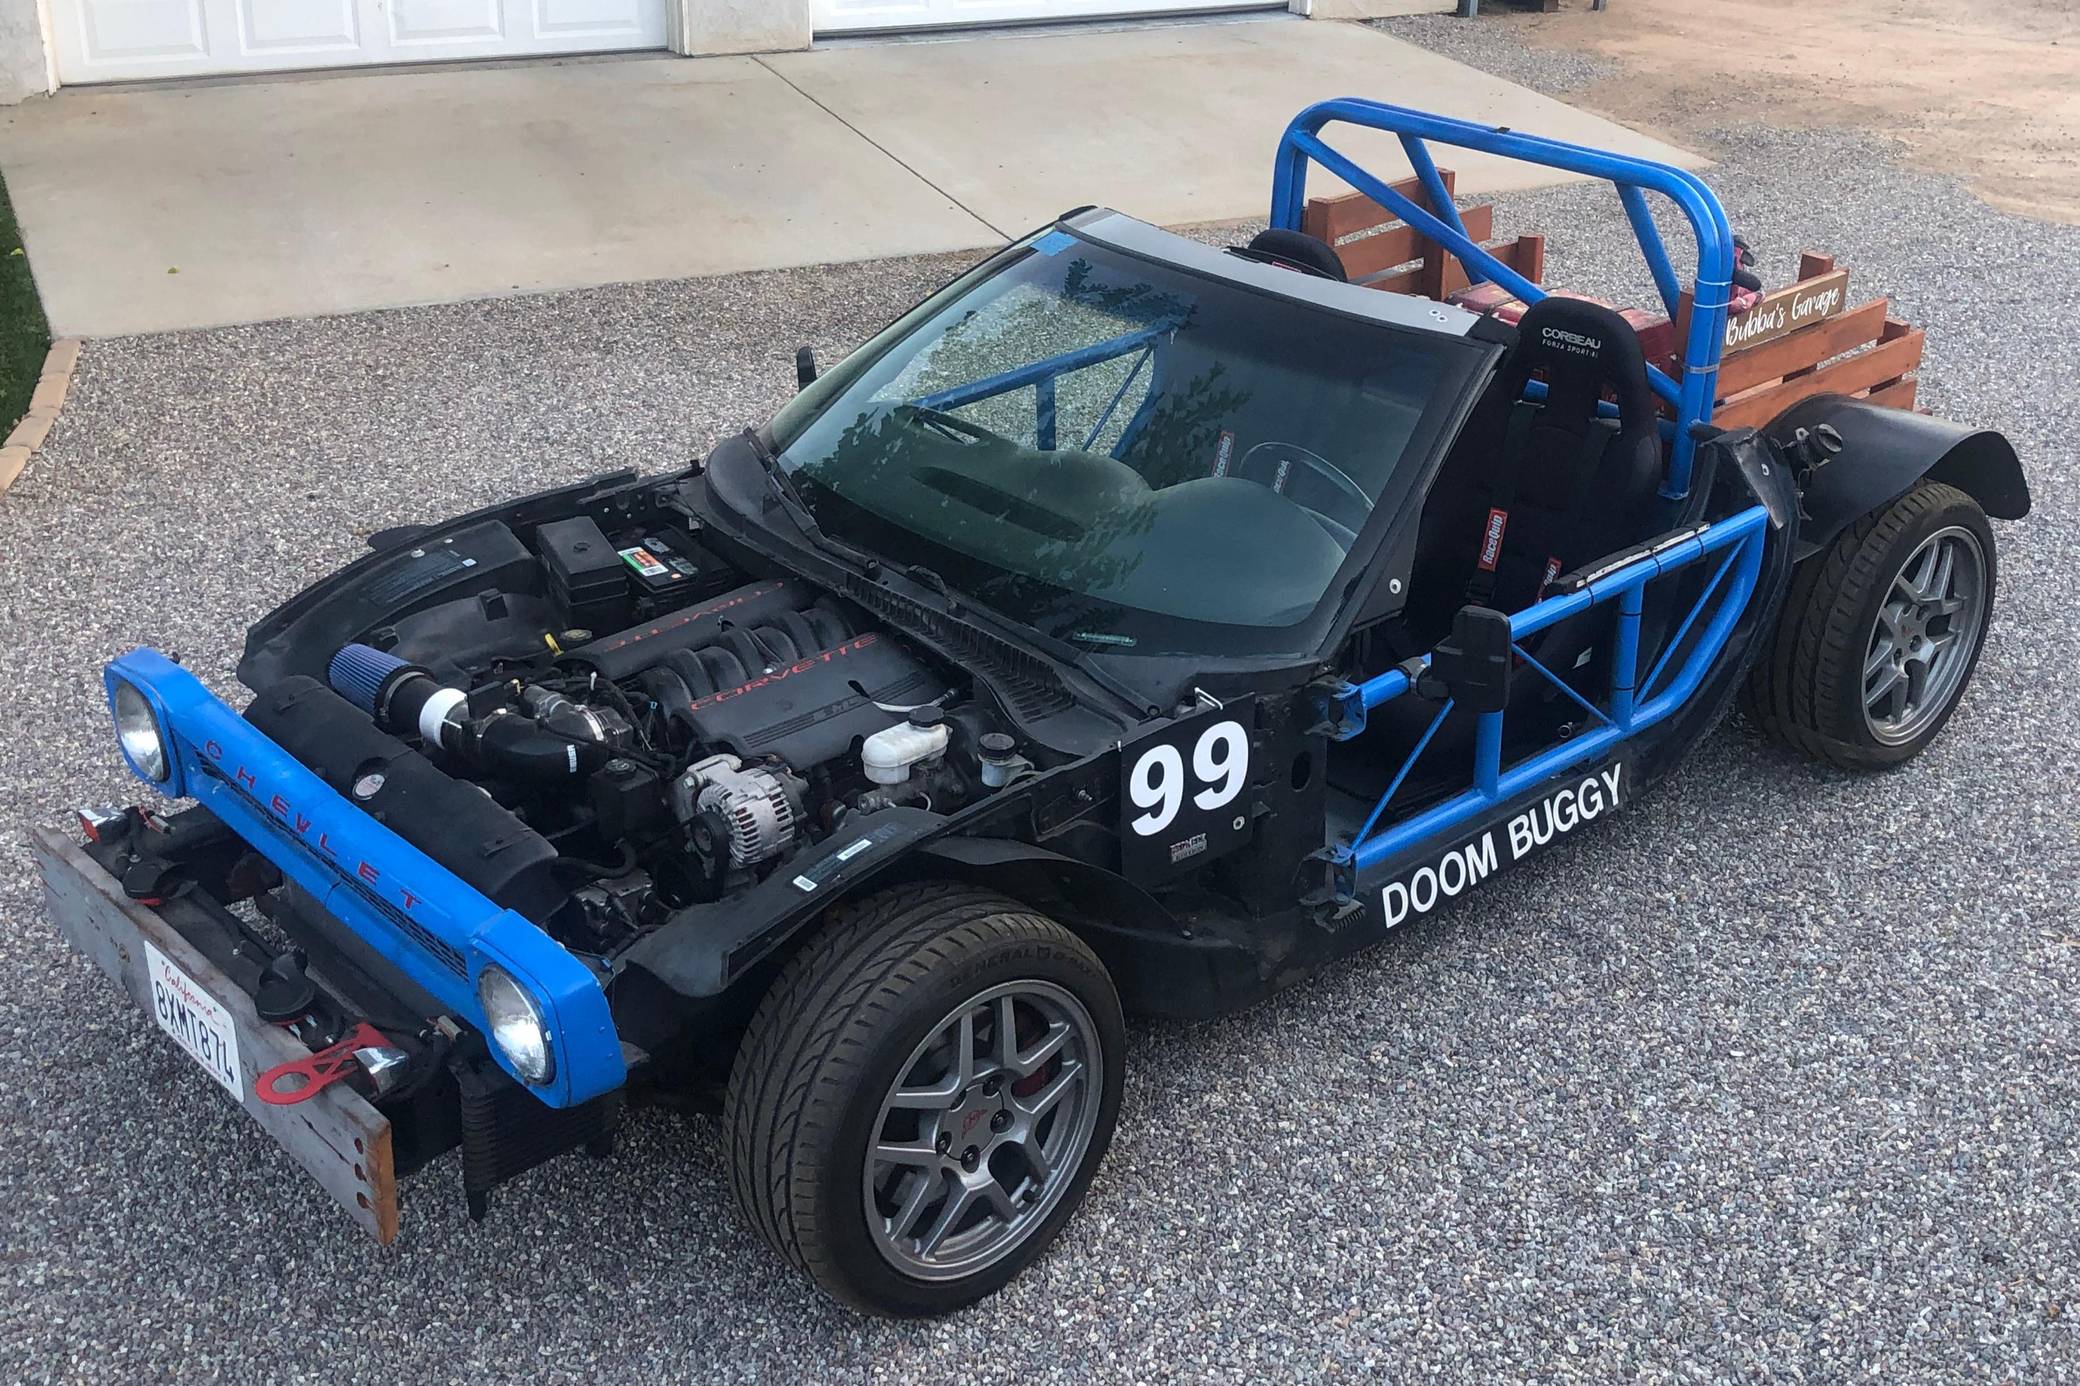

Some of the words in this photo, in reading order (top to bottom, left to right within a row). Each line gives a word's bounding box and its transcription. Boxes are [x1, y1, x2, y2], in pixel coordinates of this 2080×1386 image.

[1542, 327, 1601, 349] CORBEAU
[1725, 302, 1786, 346] Bubba's
[1791, 287, 1840, 320] Garage
[1542, 339, 1565, 350] FORZA
[1567, 344, 1590, 356] SPORT
[1482, 514, 1503, 565] RaceQuip
[691, 633, 878, 711] CORVETTE
[1129, 720, 1249, 836] 99
[1382, 831, 1499, 929] DOOM
[1507, 762, 1622, 860] BUGGY
[164, 965, 213, 1017] California
[155, 980, 235, 1084] 8XMT874
